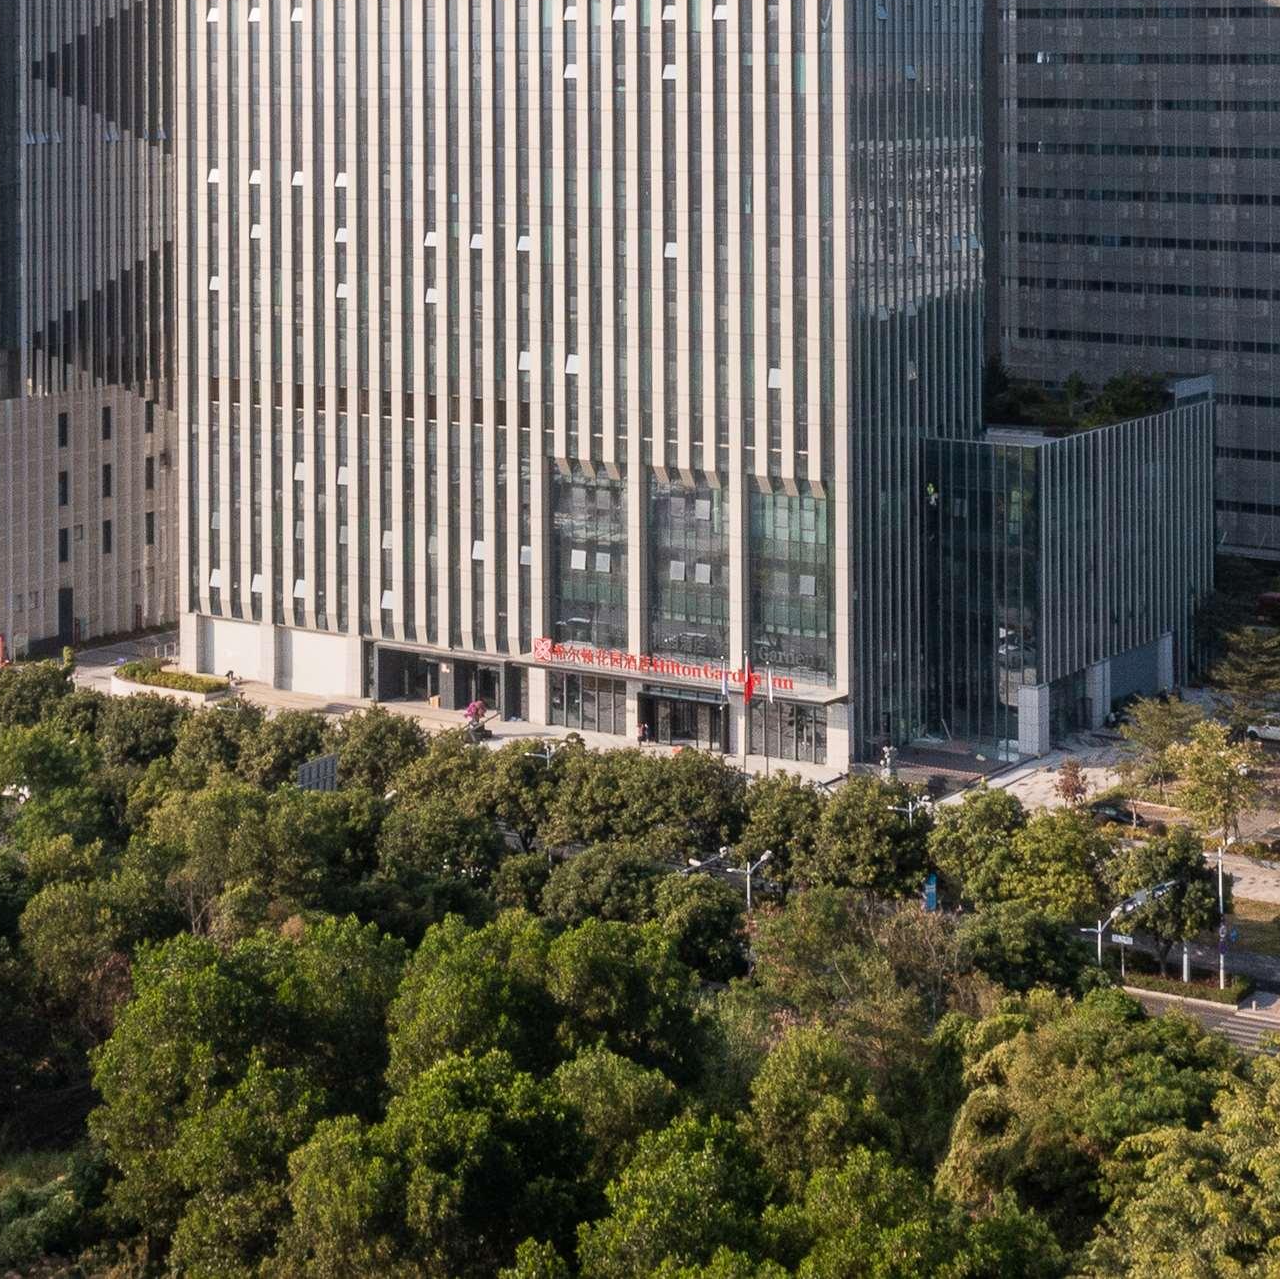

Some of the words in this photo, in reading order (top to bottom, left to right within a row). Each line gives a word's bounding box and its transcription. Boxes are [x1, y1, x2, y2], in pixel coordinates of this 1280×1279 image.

[552, 643, 650, 673] 希尔顿花园酒店
[653, 656, 701, 678] Hilton
[766, 671, 794, 689] nn
